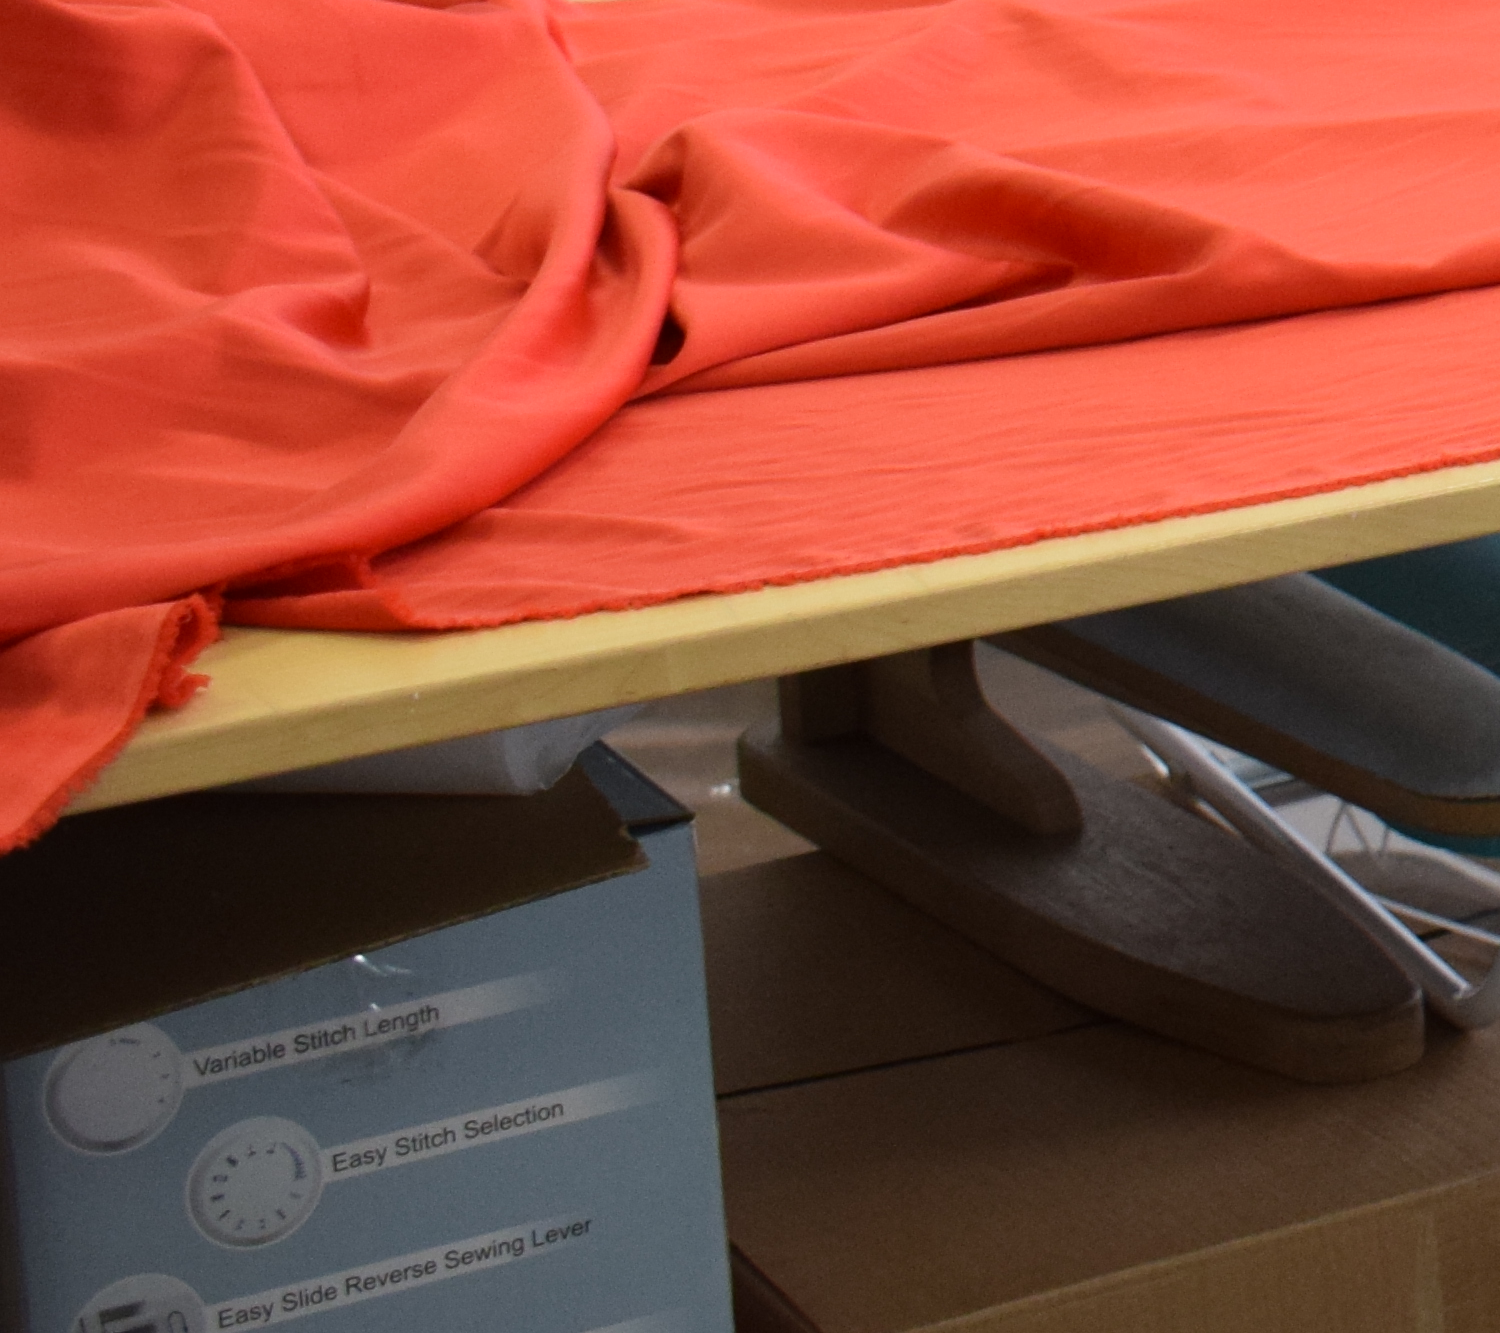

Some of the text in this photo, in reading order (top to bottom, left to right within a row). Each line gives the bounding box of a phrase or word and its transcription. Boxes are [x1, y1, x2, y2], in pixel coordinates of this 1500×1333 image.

[193, 1004, 440, 1076] Variable Stitch Length
[332, 1103, 564, 1173] Easy Stitch Selection
[217, 1219, 592, 1329] Easy Slide Reverse Sewing Lever
